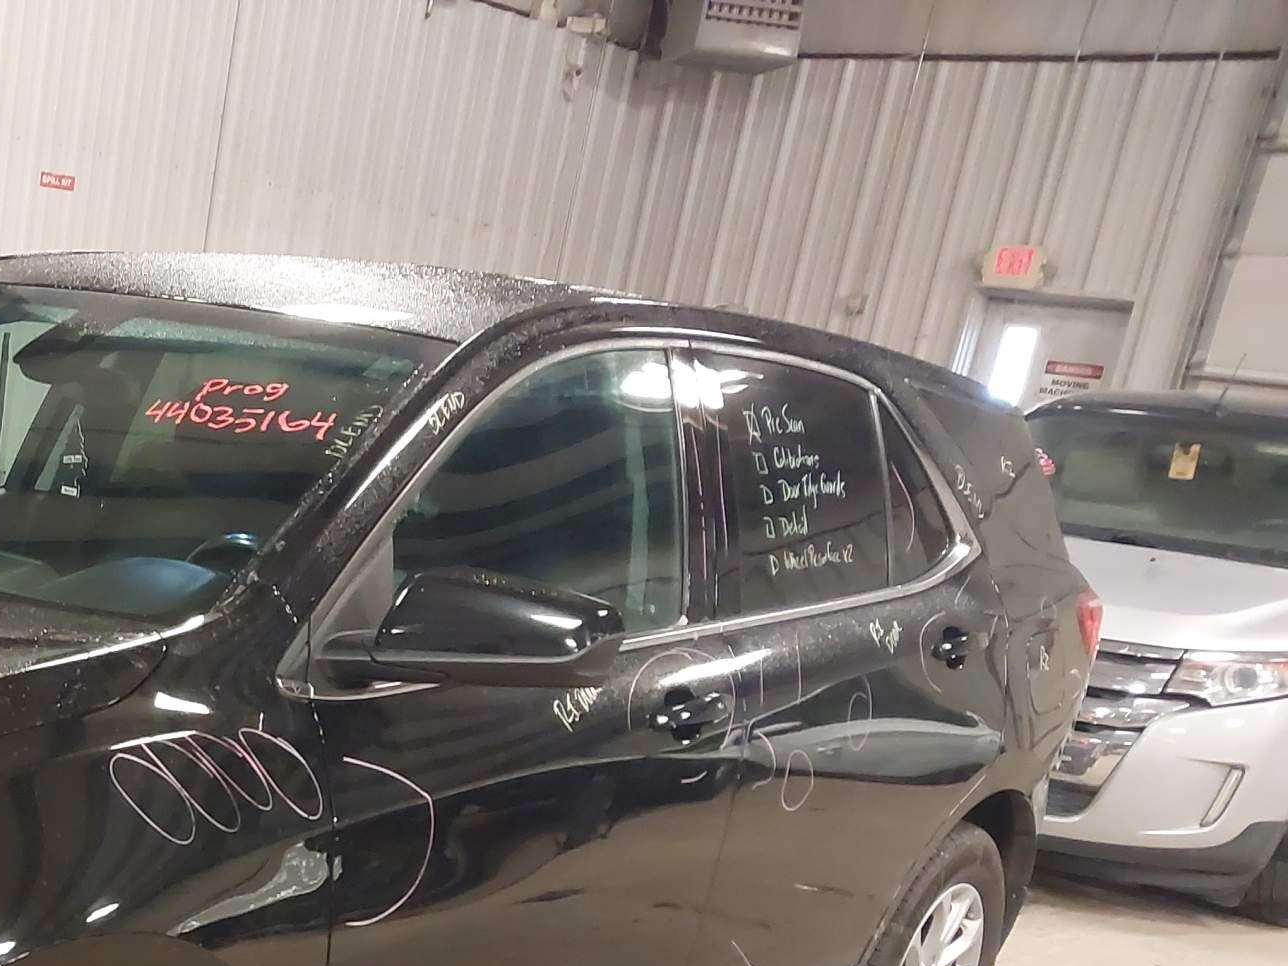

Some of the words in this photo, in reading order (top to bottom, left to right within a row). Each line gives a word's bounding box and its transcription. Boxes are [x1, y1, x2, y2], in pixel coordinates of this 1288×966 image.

[995, 248, 1034, 275] EXIT
[195, 378, 289, 402] Prog
[1051, 379, 1089, 390] MOVING
[145, 399, 337, 440] 44035164
